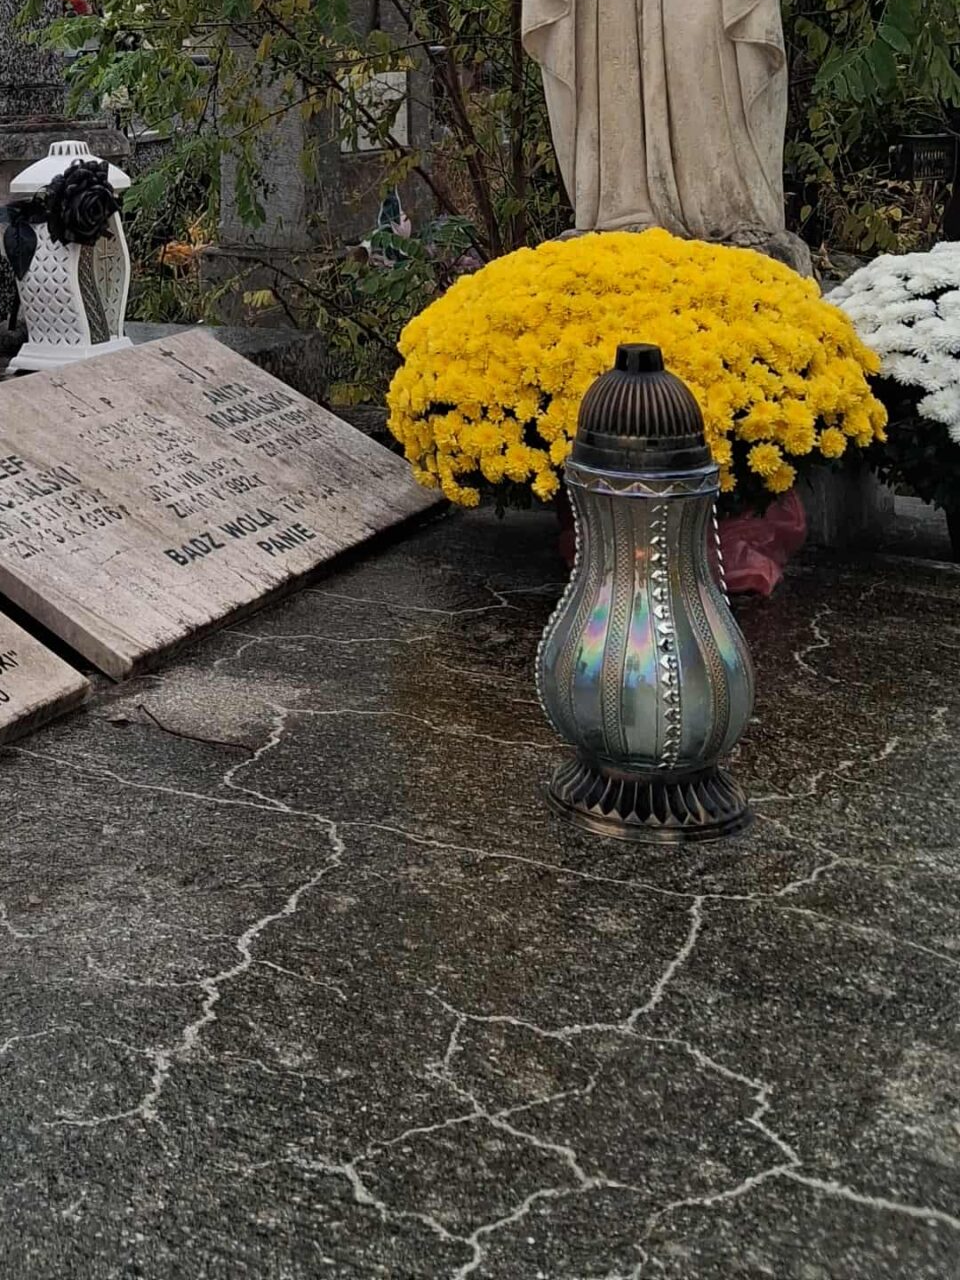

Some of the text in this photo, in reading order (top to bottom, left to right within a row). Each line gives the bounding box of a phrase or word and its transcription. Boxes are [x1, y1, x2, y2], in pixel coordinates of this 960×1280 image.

[203, 382, 254, 406] ANITA
[205, 391, 298, 431] MACHALSKA
[218, 508, 280, 539] WOLA
[256, 522, 317, 557] PANIE
